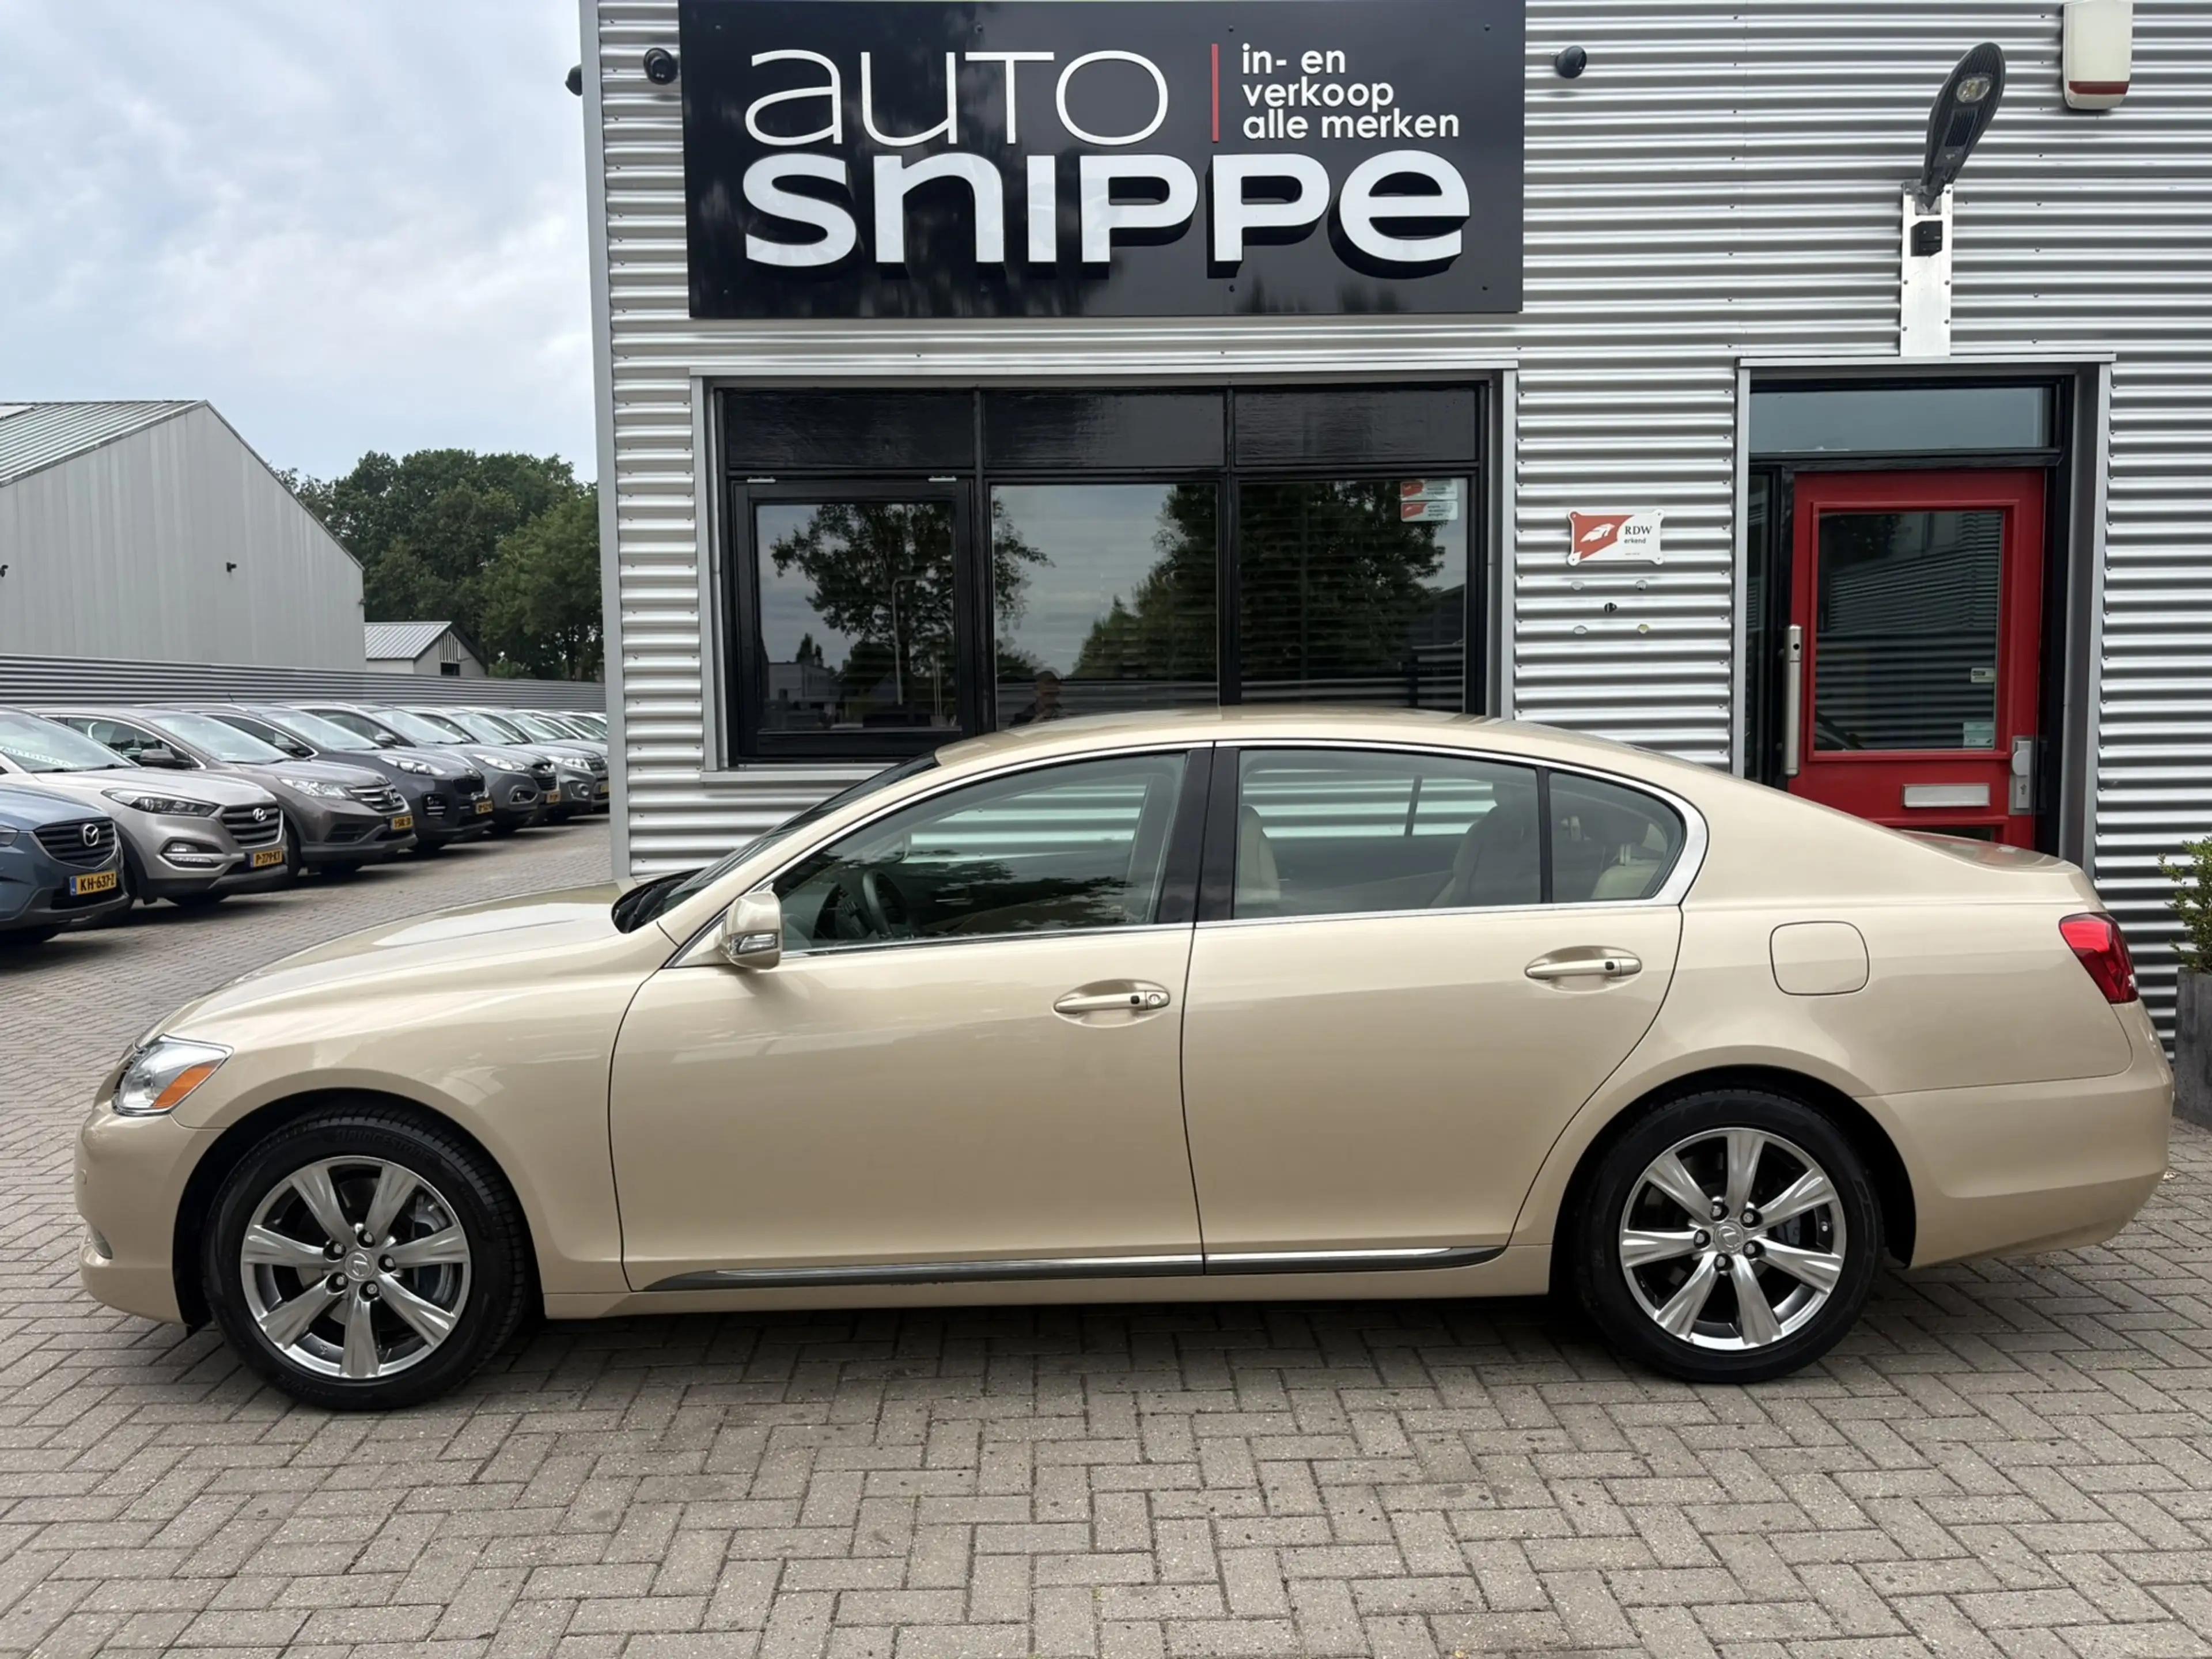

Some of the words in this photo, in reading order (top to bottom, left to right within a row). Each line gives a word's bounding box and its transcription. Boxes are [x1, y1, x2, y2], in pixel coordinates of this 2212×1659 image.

[1243, 43, 1287, 74] in-
[1301, 50, 1346, 74] en
[1242, 76, 1394, 113] verkoop
[1243, 108, 1309, 139] alle
[1321, 108, 1459, 138] merken
[1624, 525, 1653, 535] RDW
